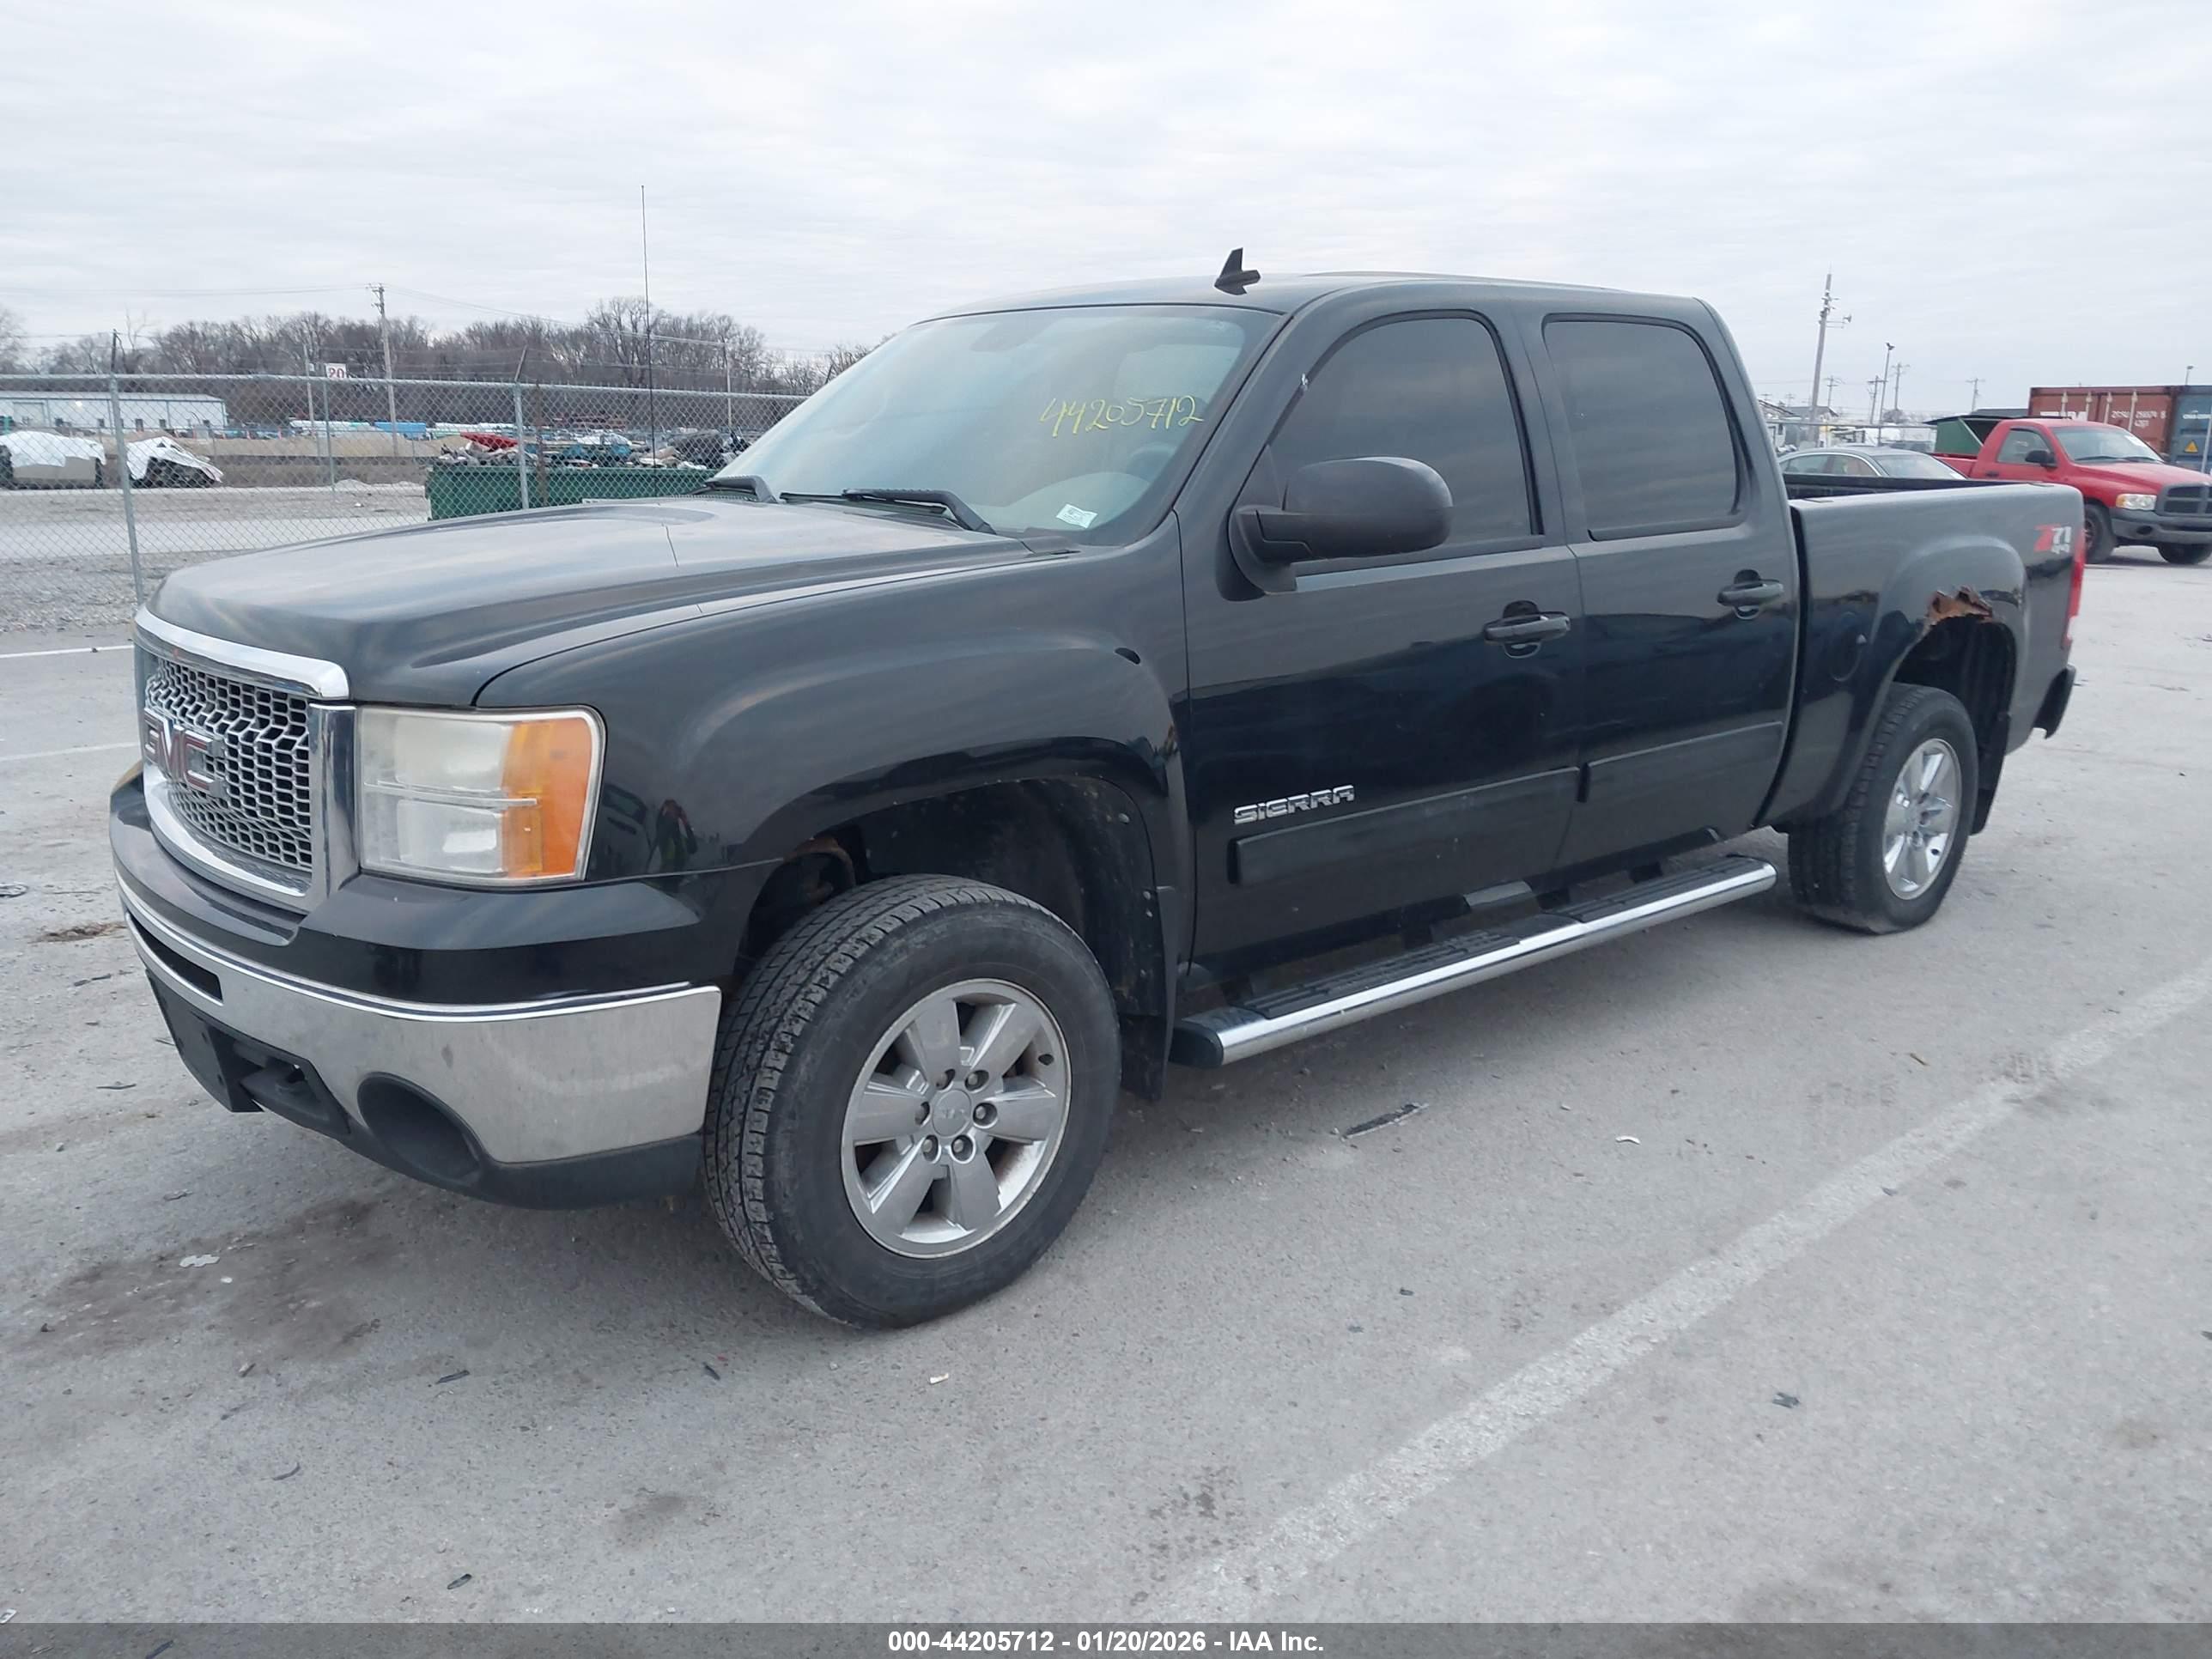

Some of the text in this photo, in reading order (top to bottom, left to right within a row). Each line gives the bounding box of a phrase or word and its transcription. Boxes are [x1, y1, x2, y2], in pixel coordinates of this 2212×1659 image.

[1039, 395, 1204, 437] 44205712
[2033, 523, 2071, 552] Z71
[1234, 784, 1355, 824] SIERRA
